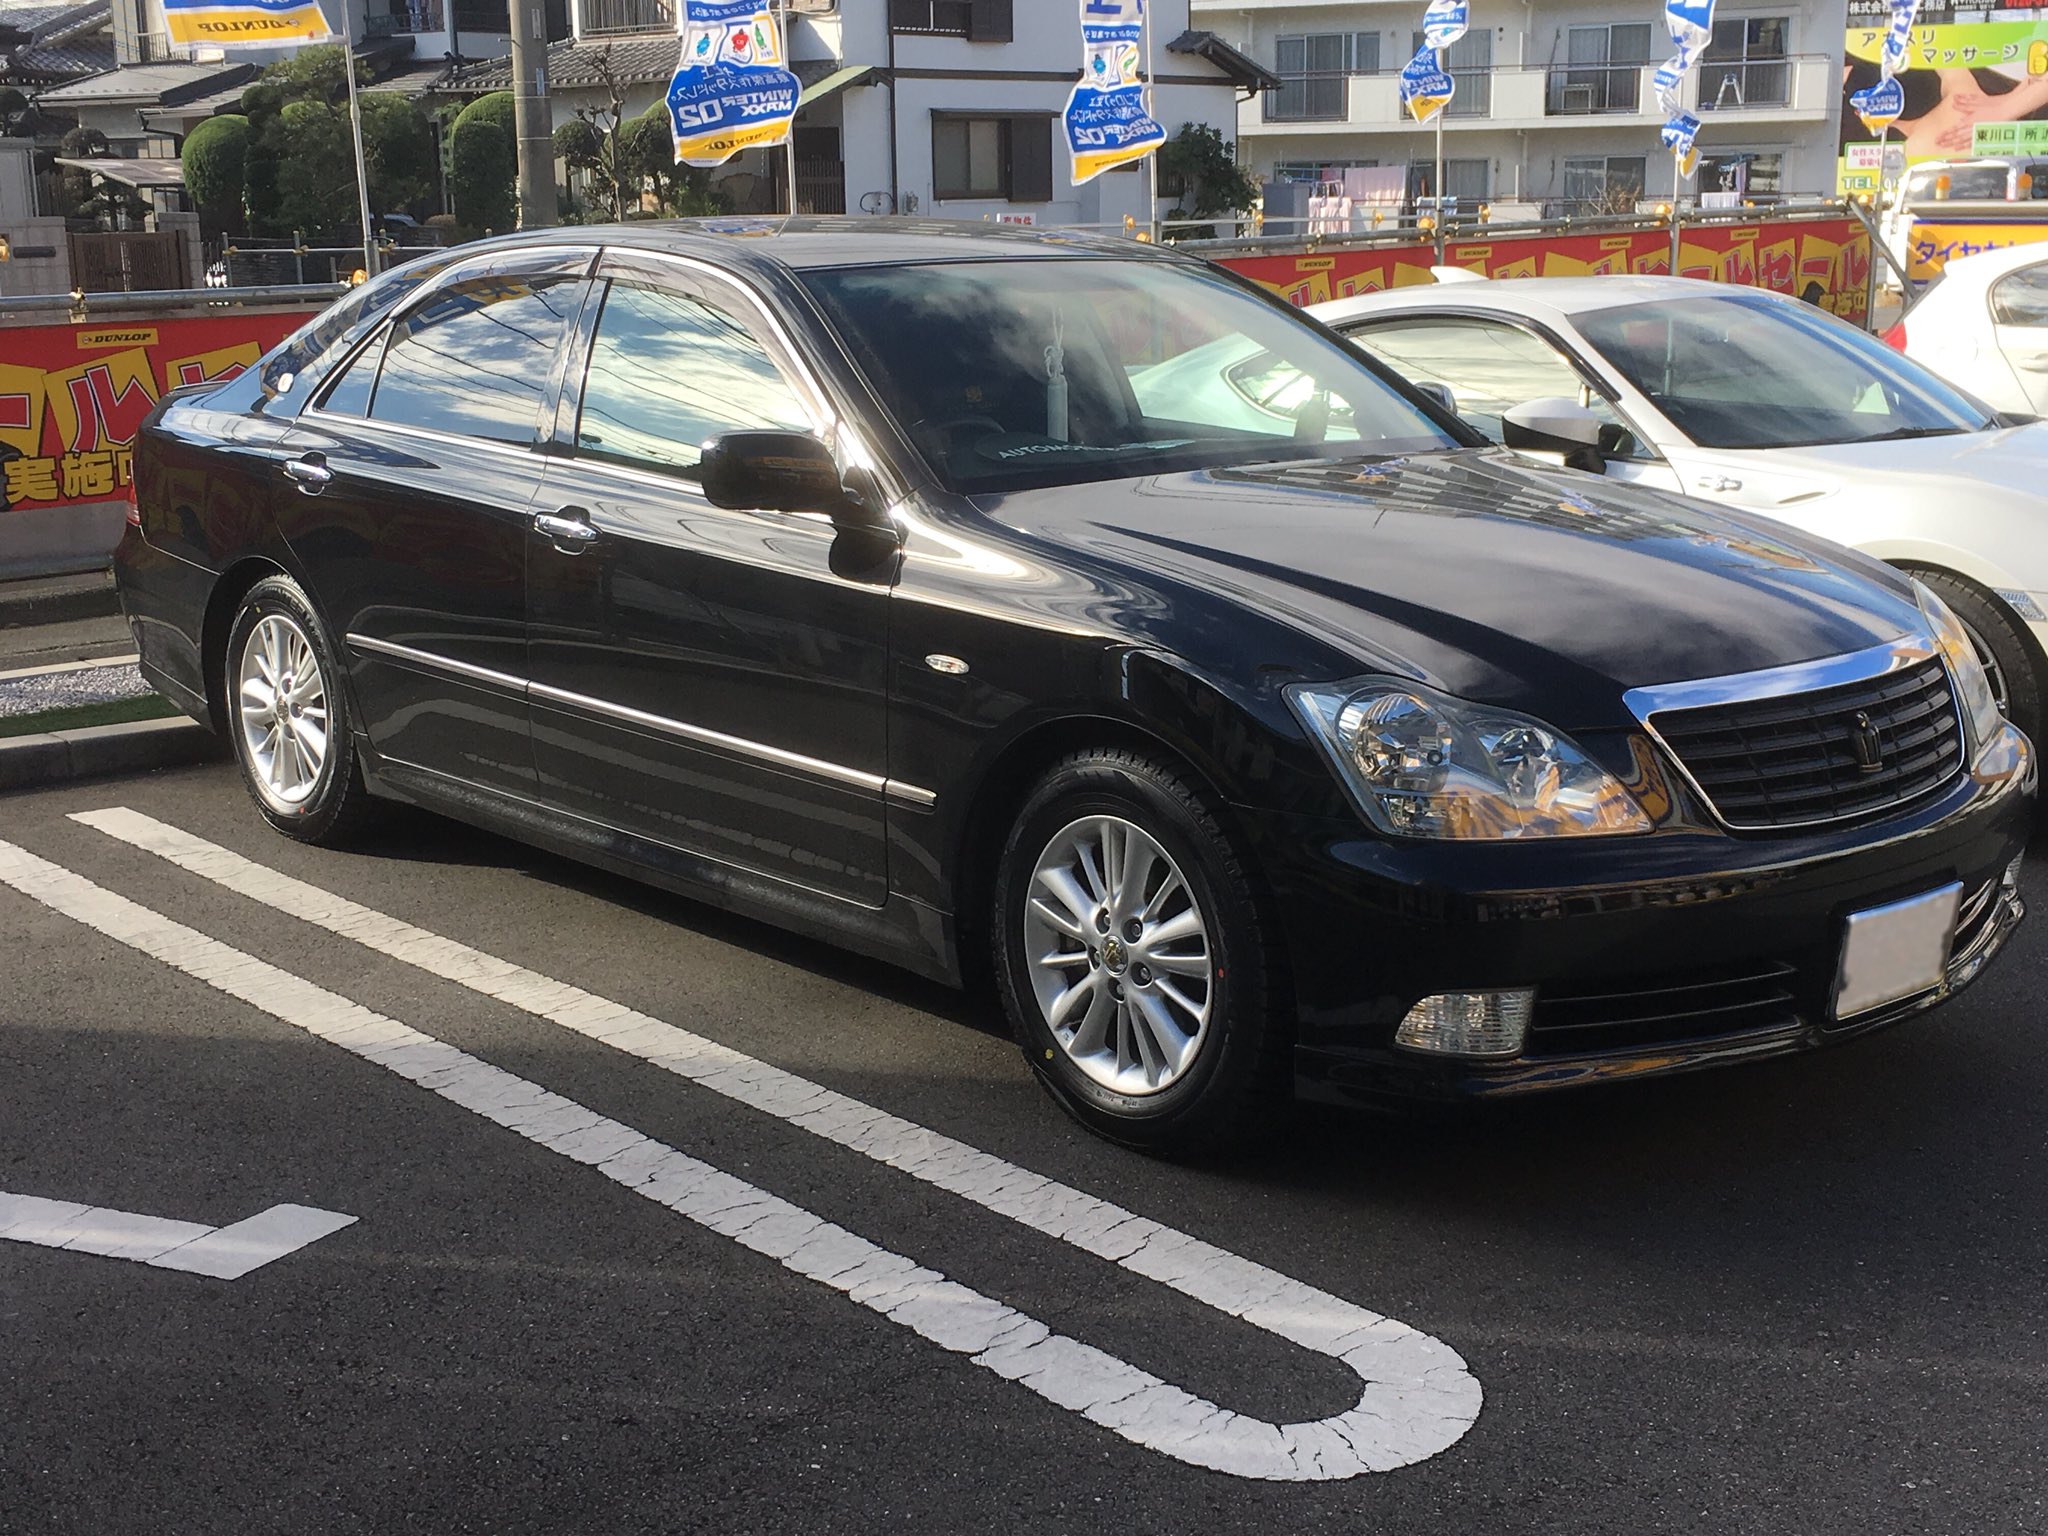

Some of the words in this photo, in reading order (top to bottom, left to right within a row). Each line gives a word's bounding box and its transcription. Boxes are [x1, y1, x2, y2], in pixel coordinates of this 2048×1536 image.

[1922, 44, 2019, 63] マッサージ
[1976, 129, 2015, 142] 東川口
[93, 332, 151, 343] DUNLOP
